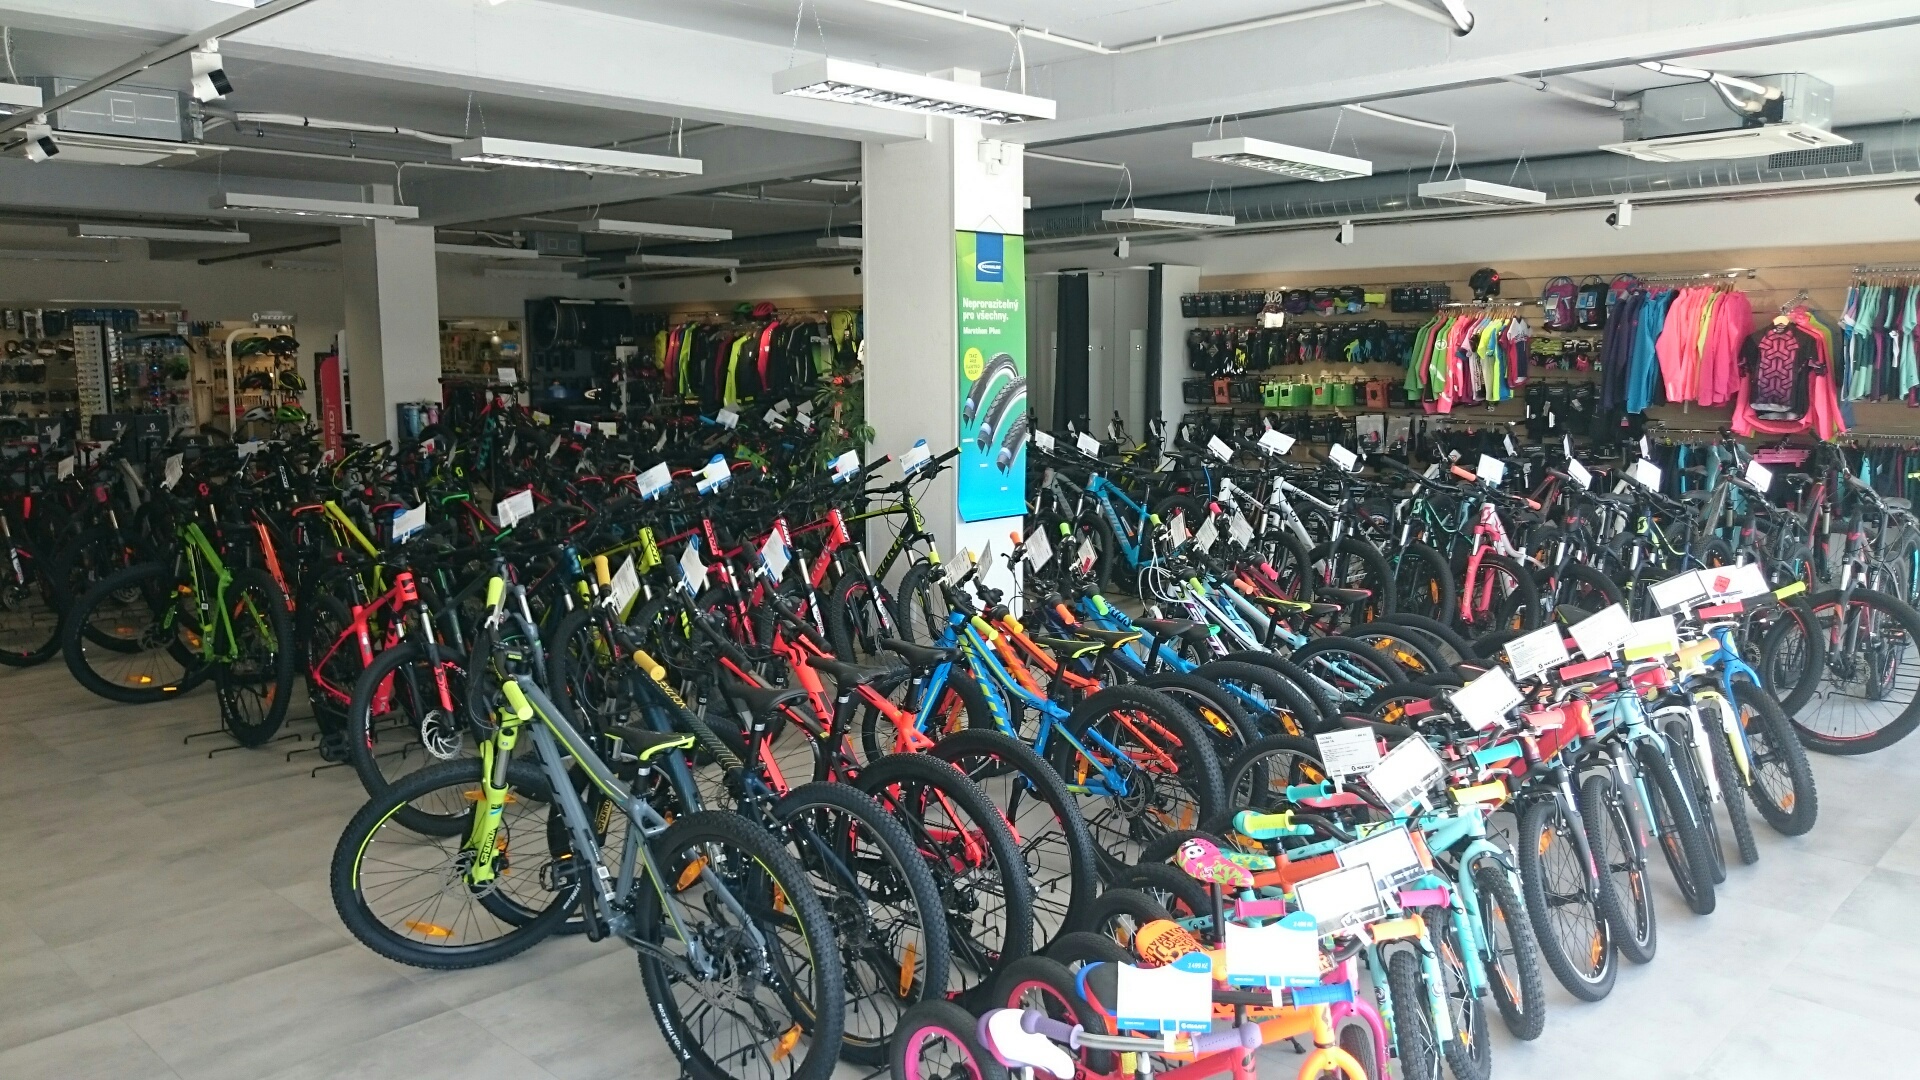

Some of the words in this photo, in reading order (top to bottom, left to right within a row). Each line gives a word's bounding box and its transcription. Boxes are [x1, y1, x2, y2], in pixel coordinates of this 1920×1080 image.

[962, 297, 1019, 312] Neprorazitelný
[962, 311, 975, 322] pro
[976, 309, 1009, 323] všechny.
[780, 517, 793, 548] GIANT
